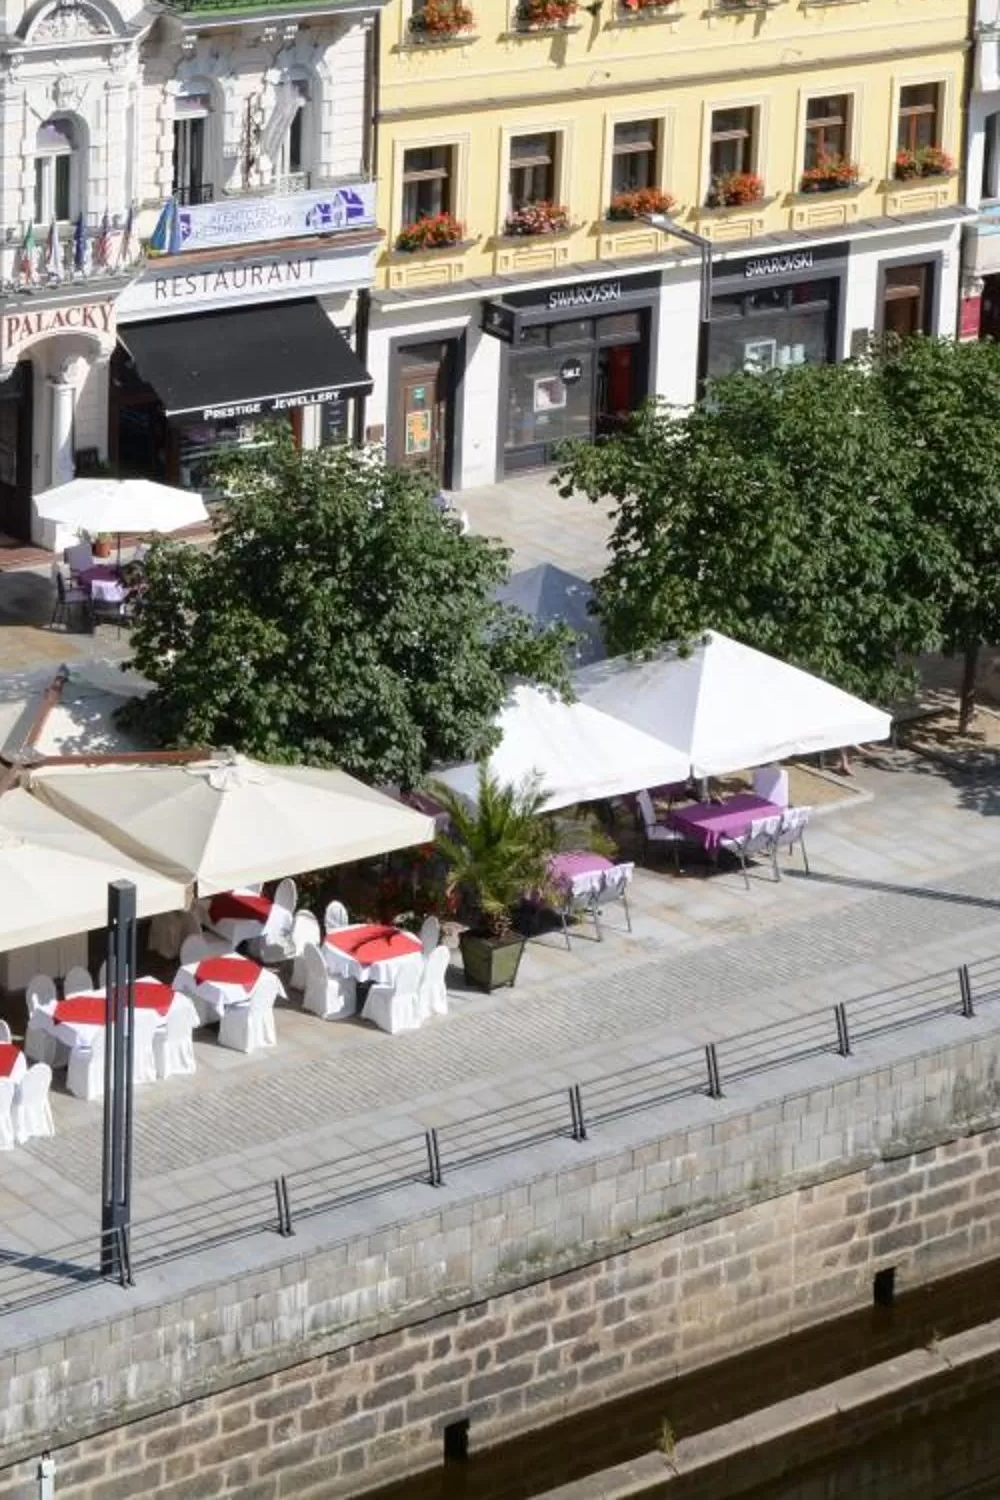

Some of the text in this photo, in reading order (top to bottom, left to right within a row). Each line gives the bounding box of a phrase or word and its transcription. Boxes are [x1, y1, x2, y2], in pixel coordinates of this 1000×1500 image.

[155, 257, 318, 299] RESTAURANT
[745, 251, 814, 277] SWAROVSKI
[548, 283, 622, 309] SWAROVSKI
[203, 391, 340, 421] PRESTIGE JEWELLERY
